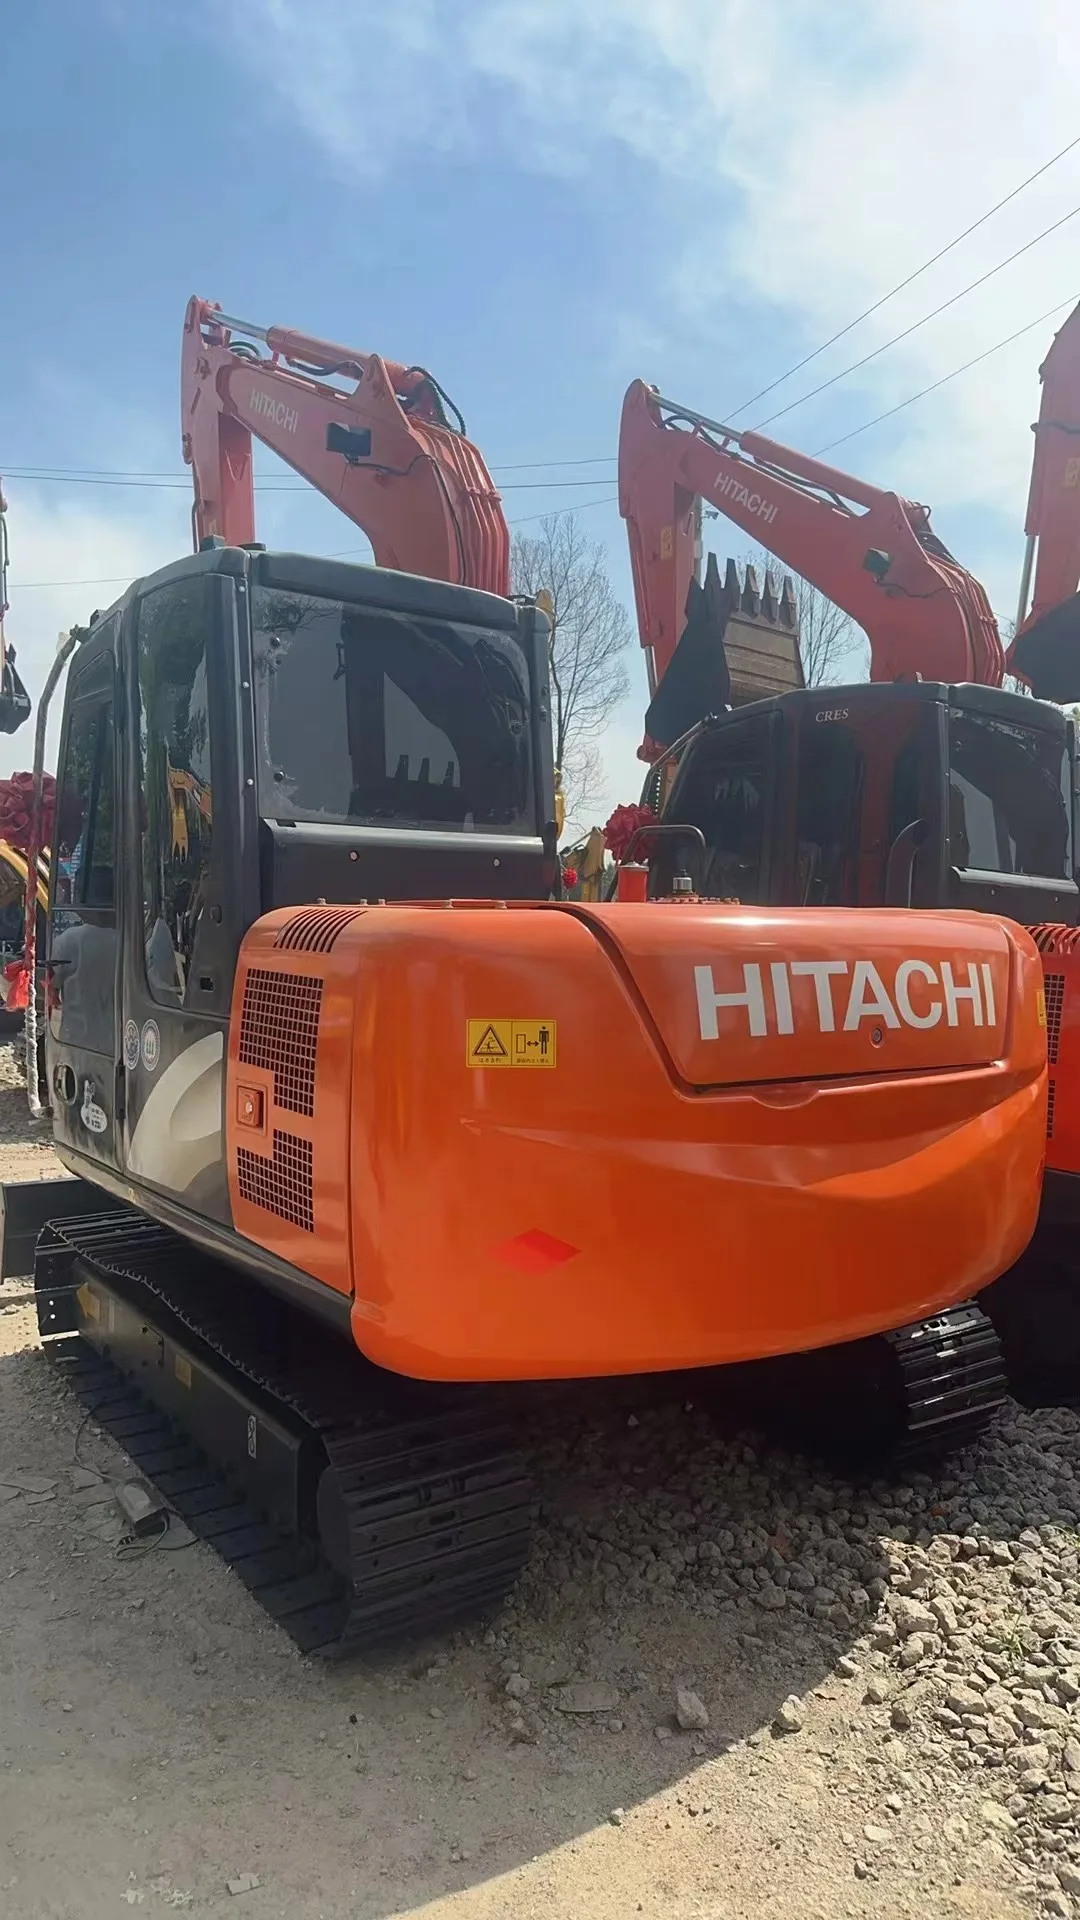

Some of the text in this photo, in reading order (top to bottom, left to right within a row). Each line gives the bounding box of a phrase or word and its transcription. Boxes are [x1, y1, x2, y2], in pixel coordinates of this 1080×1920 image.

[250, 389, 298, 434] HITACHI
[714, 472, 778, 524] HITACHI
[815, 708, 849, 722] CRES
[694, 960, 996, 1040] HITACHI
